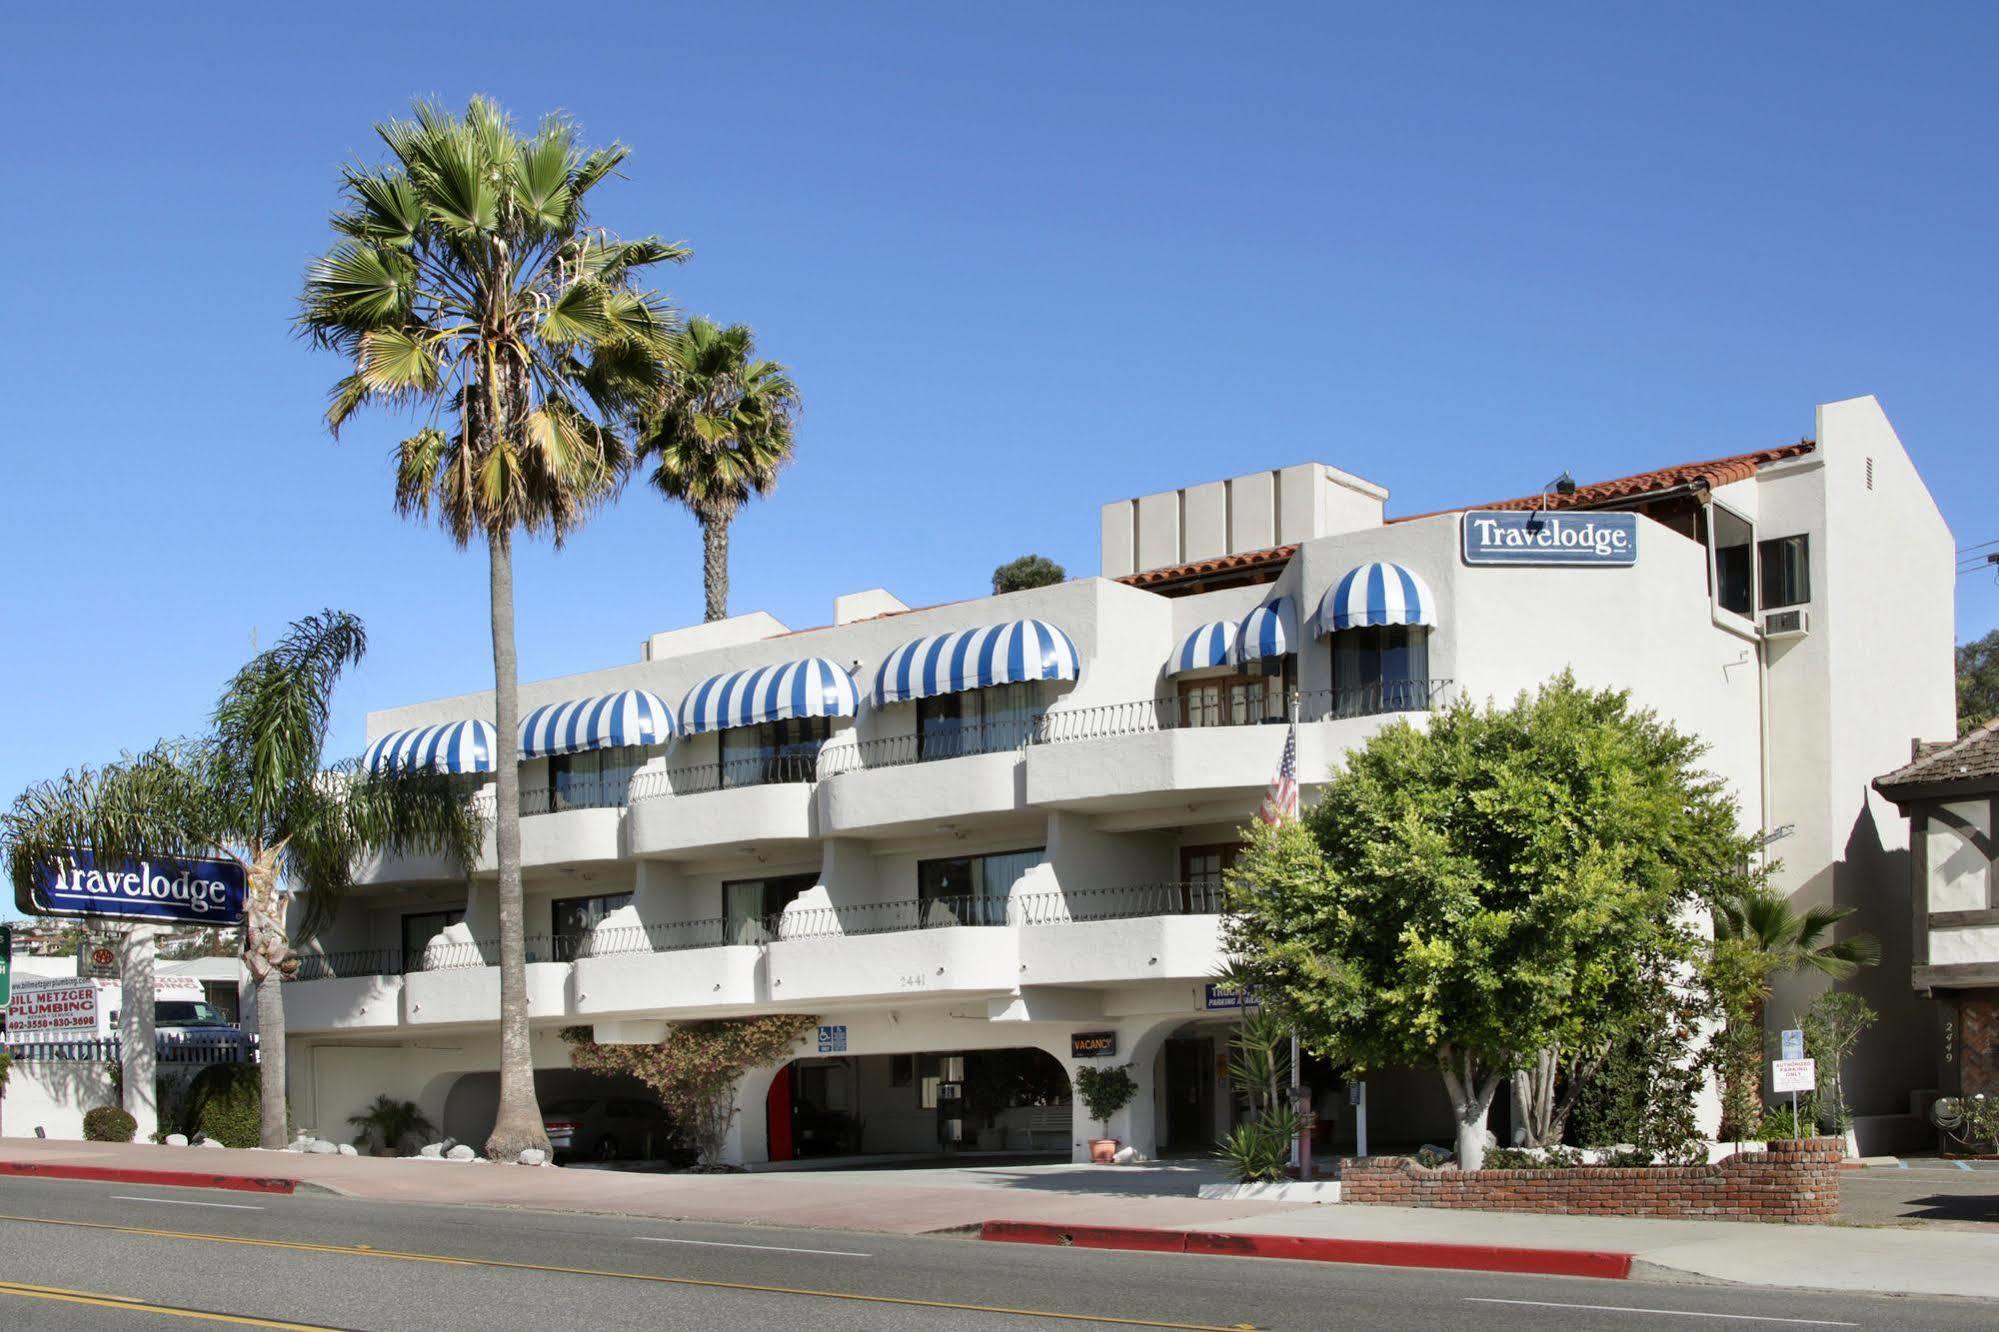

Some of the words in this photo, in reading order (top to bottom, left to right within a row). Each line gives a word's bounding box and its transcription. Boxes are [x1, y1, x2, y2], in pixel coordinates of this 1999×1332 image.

[1474, 519, 1627, 555] Travelodge
[55, 856, 226, 912] Travelodge
[37, 989, 93, 1003] METZGER
[1208, 997, 1236, 1007] PARKING
[9, 1001, 94, 1016] PLUMBING
[1075, 1039, 1112, 1049] VACANCY
[1944, 1022, 1953, 1063] 2449
